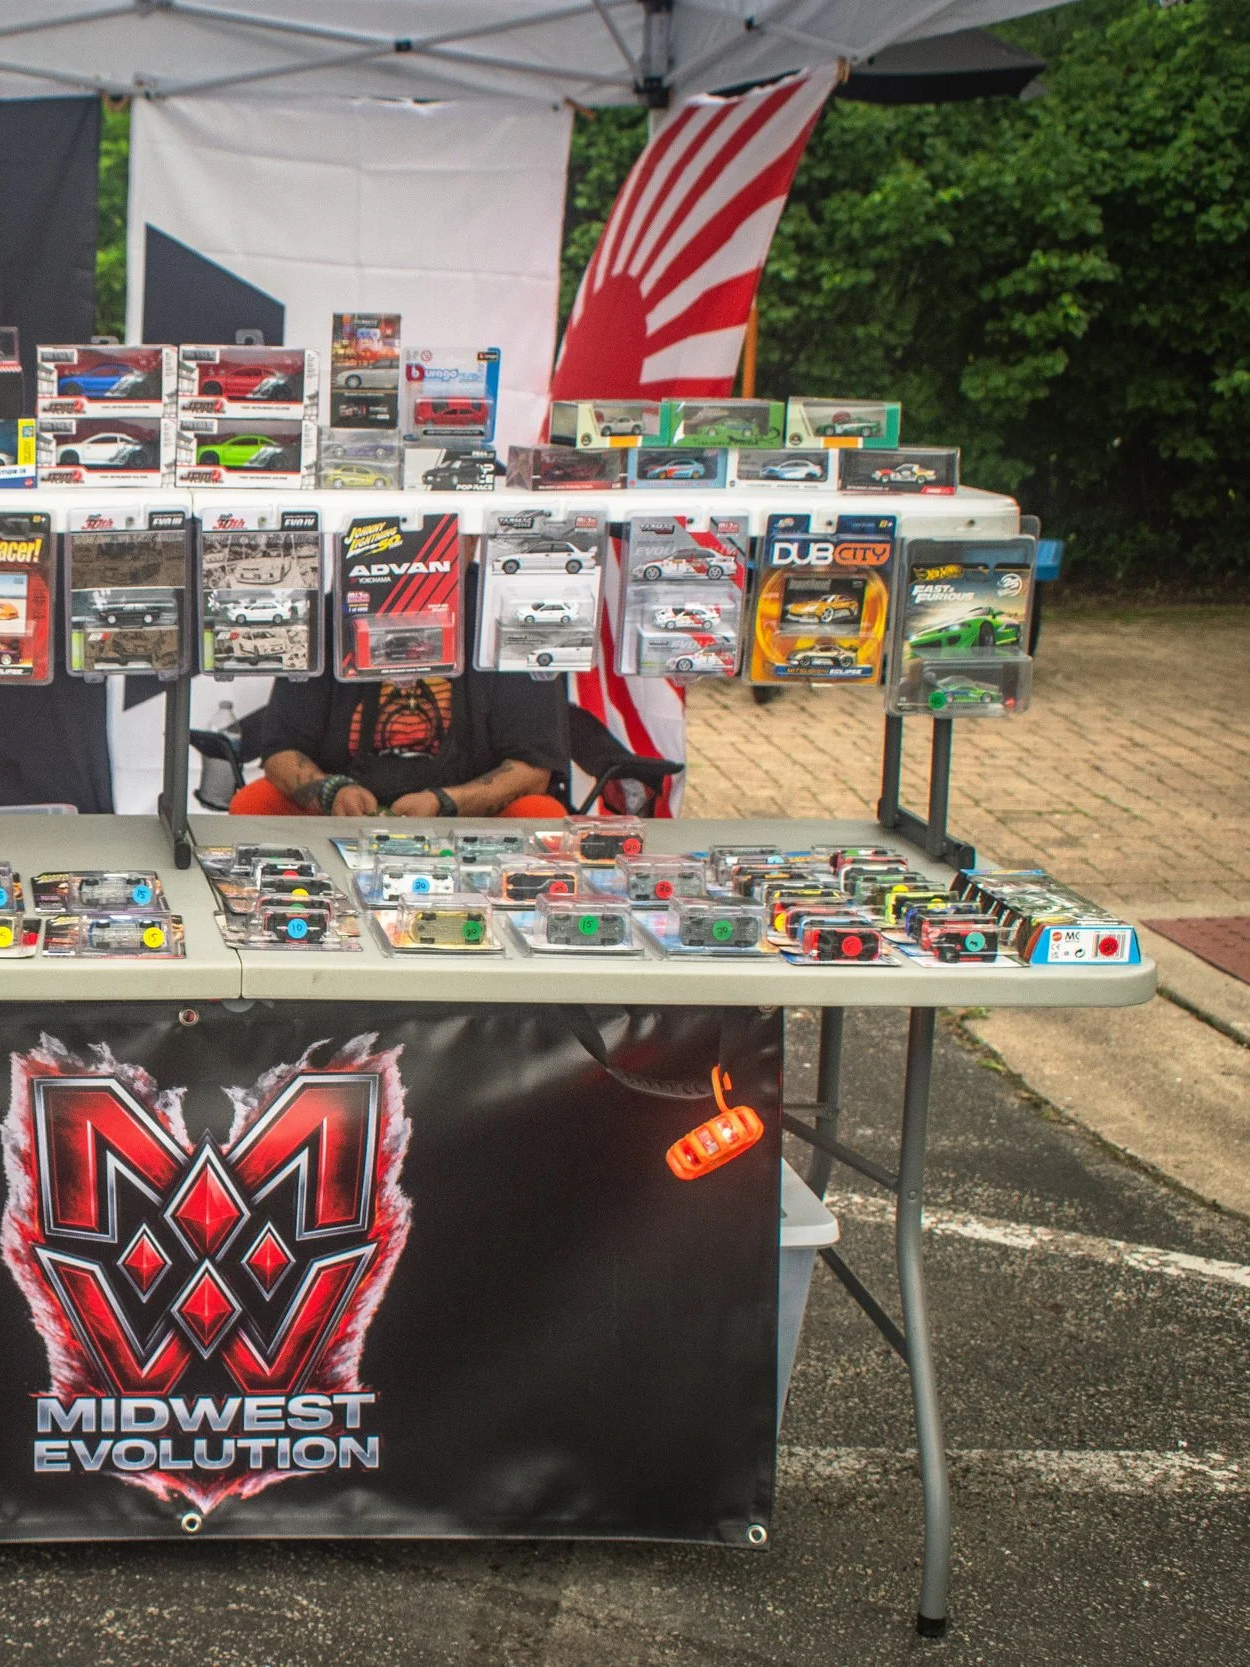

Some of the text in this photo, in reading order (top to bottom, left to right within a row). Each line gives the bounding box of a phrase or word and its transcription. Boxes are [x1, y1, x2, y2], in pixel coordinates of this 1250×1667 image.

[344, 522, 387, 544] JOHNNY
[348, 527, 398, 552] LIGHTNING
[771, 542, 887, 565] DUB CITY
[348, 561, 451, 577] ADVAN
[358, 576, 392, 584] YOKOHAMA
[915, 592, 975, 604] FURIOUS
[292, 923, 303, 932] 10
[582, 919, 593, 929] 15
[36, 1392, 376, 1433] MIDWEST
[33, 1436, 381, 1473] EVOLUTION
